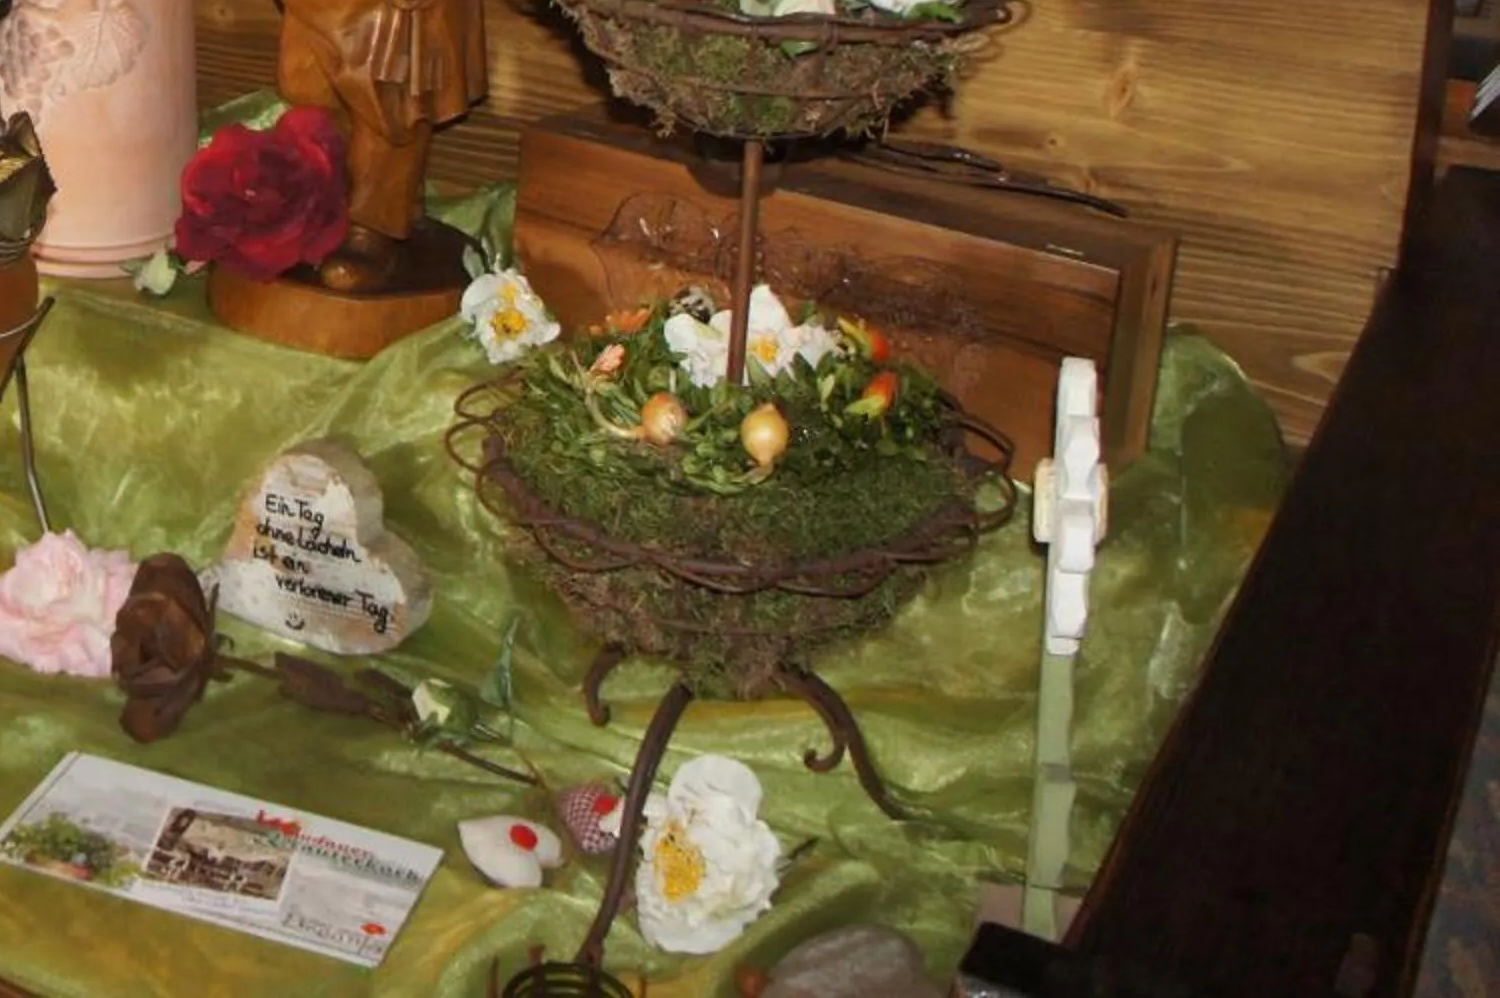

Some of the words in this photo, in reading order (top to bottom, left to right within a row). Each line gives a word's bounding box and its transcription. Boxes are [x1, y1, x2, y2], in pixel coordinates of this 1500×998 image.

[256, 516, 294, 546] ohne
[265, 492, 295, 518] Ein
[294, 498, 324, 540] Tag
